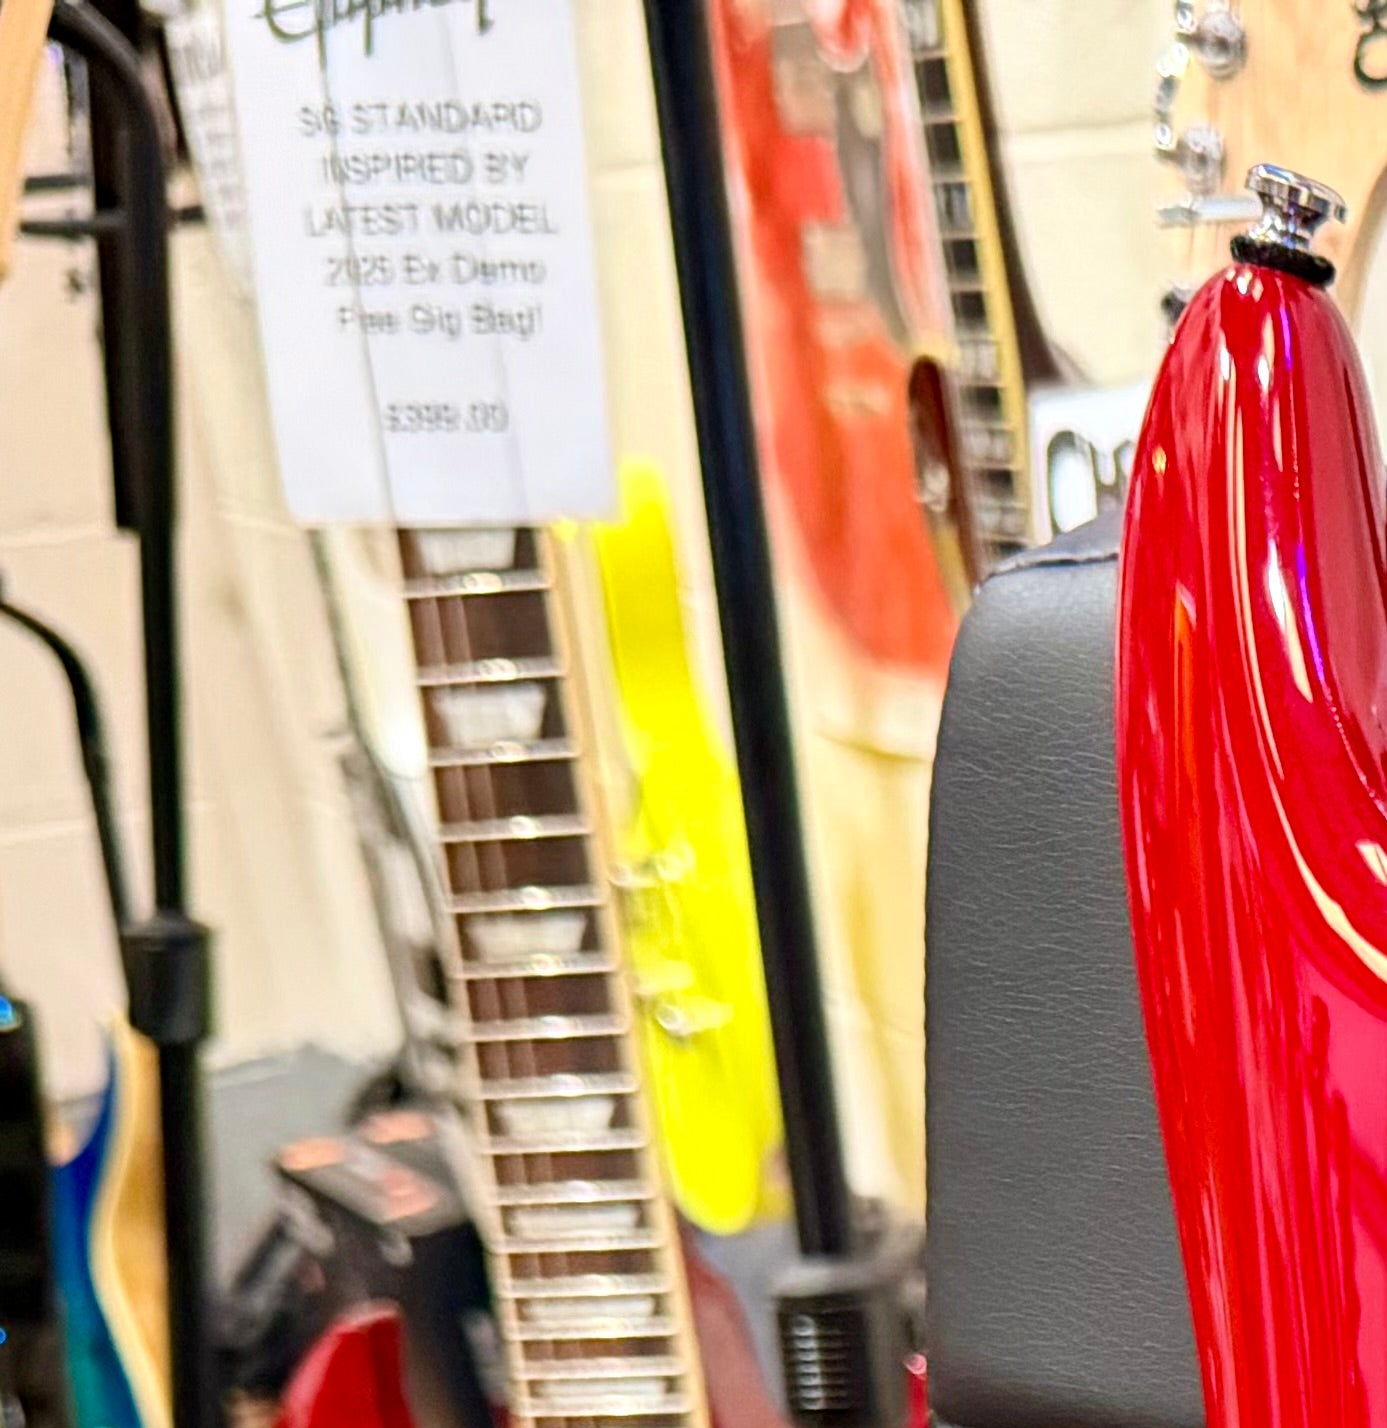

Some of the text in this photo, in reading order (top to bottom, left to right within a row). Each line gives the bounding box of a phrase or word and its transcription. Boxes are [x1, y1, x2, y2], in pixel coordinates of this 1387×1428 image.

[298, 101, 544, 138] SG STANDARD
[322, 151, 530, 186] INSPIRED BY
[303, 201, 559, 239] LATEST MODEL
[324, 252, 548, 287] 2025 Ex Demo
